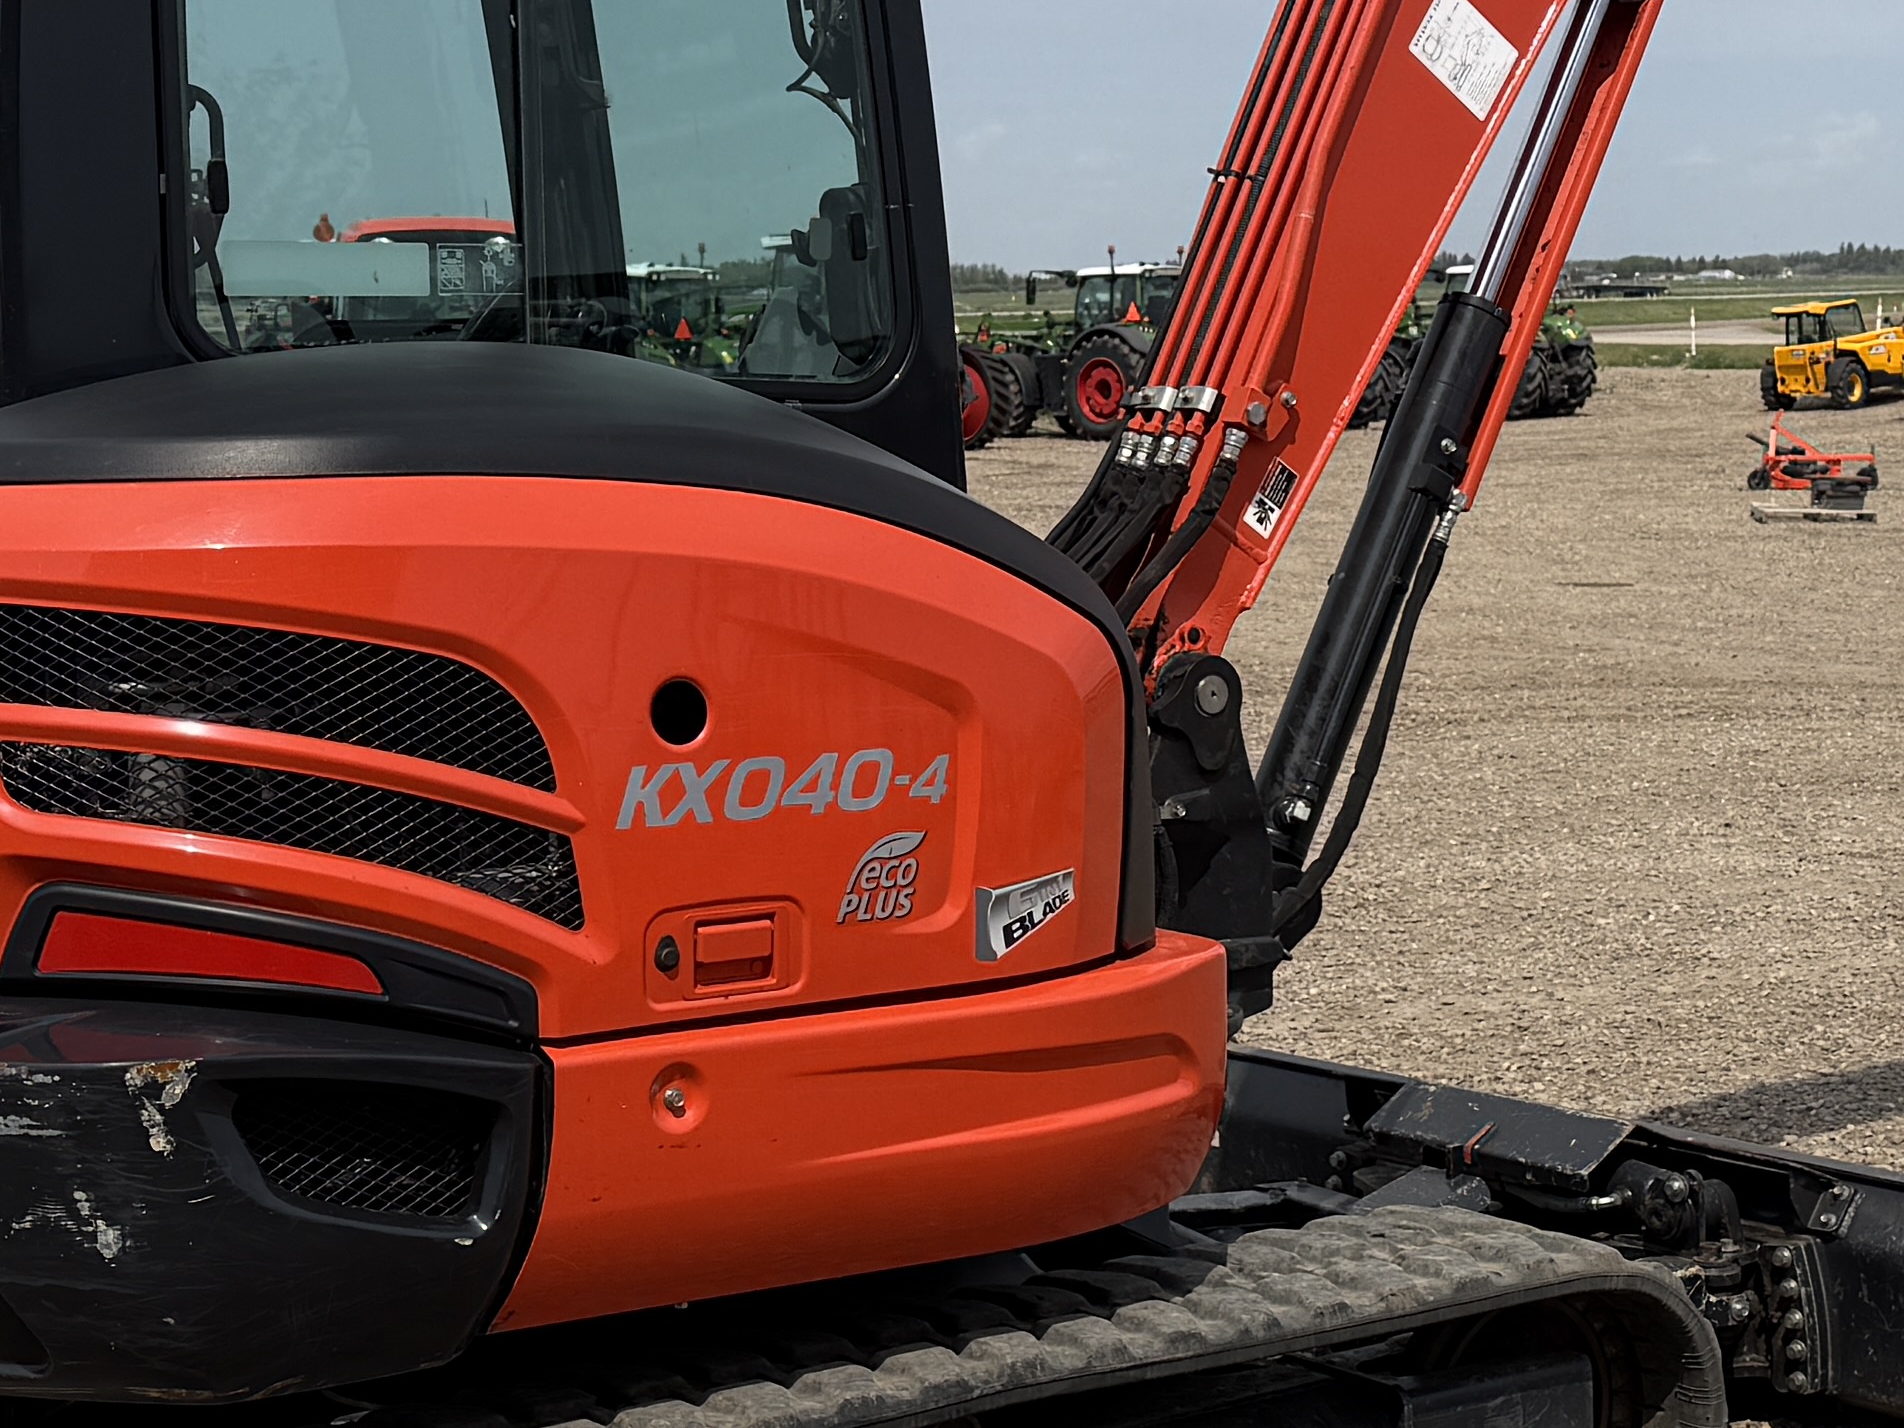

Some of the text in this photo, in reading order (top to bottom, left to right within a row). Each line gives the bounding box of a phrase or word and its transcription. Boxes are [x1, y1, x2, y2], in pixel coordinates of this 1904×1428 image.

[615, 747, 950, 830] KX040-4
[860, 857, 919, 891] eco
[836, 887, 916, 925] PLUS
[1002, 889, 1071, 950] BLADE
